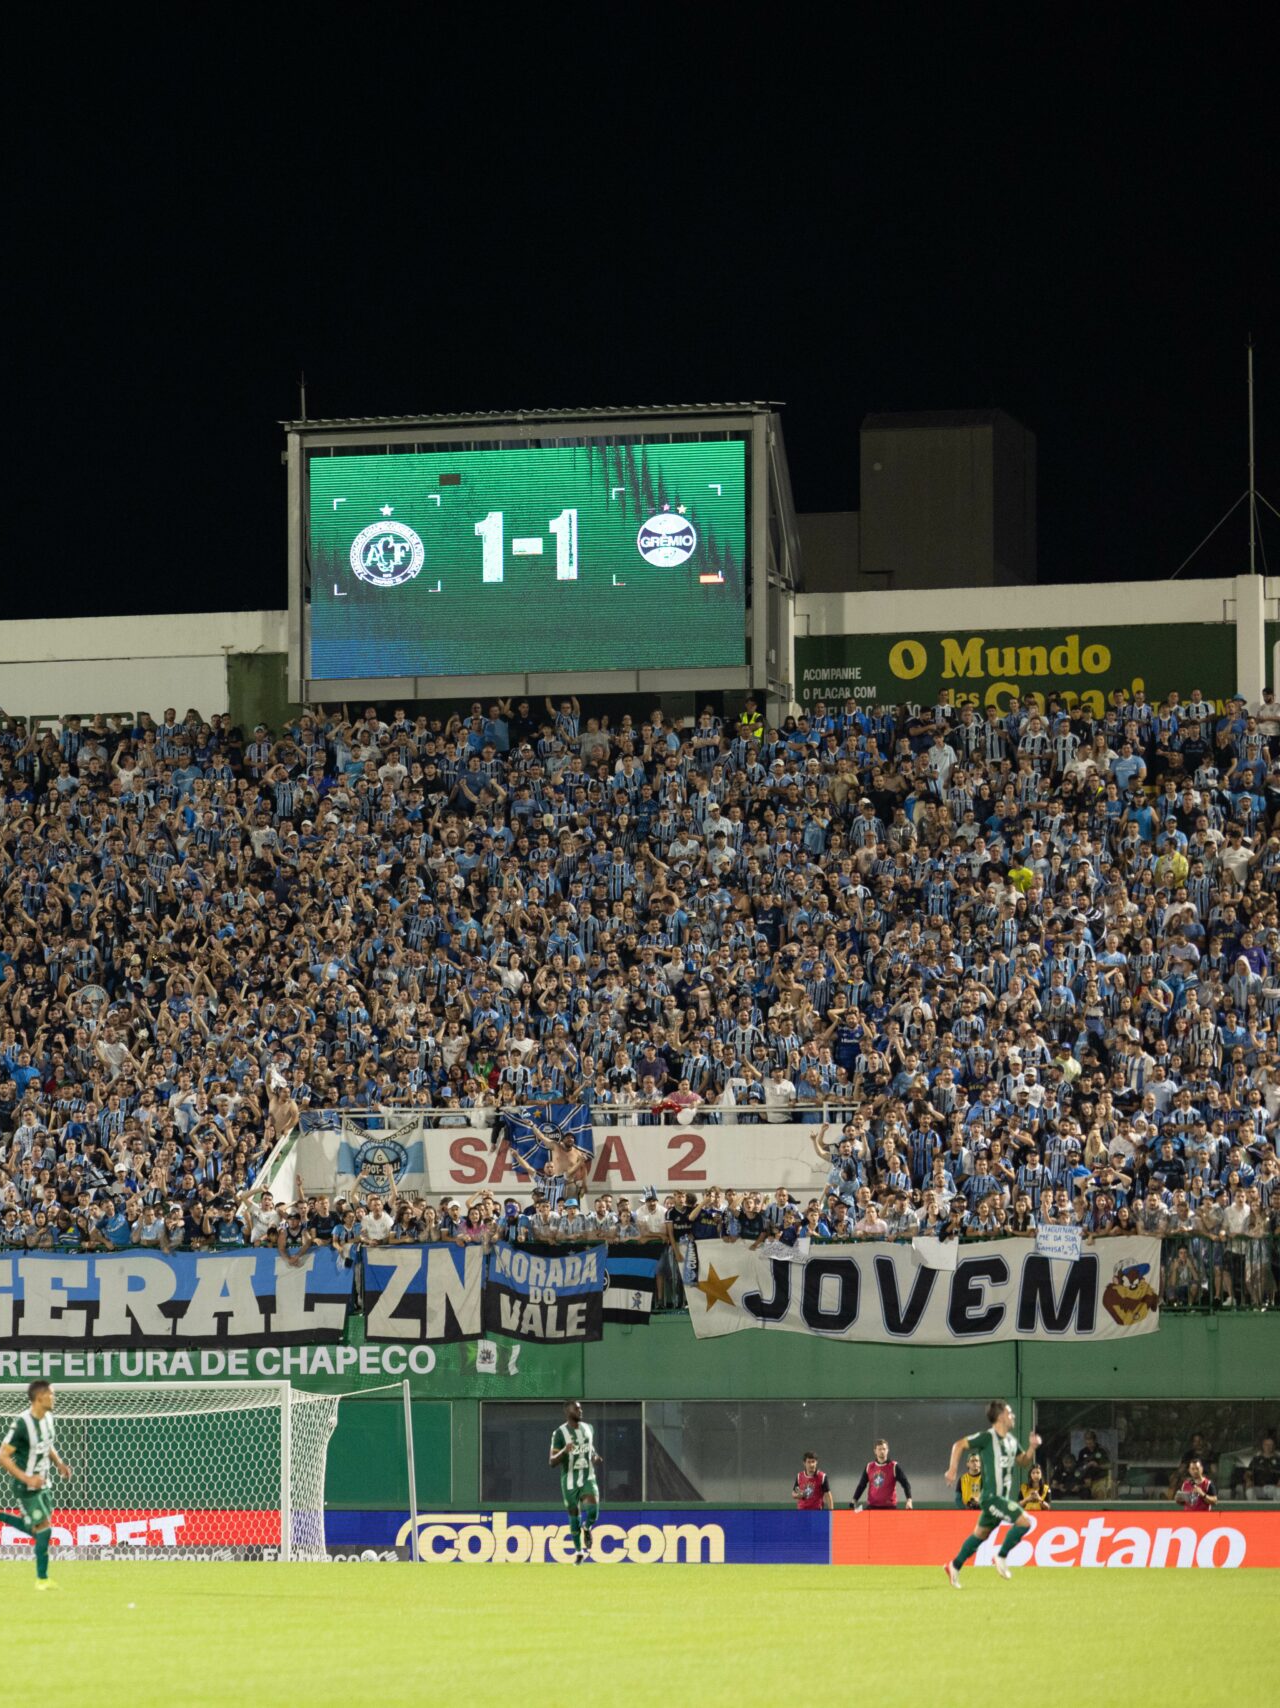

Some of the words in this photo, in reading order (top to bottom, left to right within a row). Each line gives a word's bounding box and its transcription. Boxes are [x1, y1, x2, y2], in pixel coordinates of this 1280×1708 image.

[640, 532, 693, 548] GRÊMIO
[803, 667, 862, 681] ACOMPANHE
[889, 640, 927, 680] O
[940, 634, 1111, 678] Mundo
[803, 688, 810, 700] O
[813, 687, 851, 700] PLACAR
[854, 686, 877, 698] COM
[667, 1134, 707, 1181] 2
[495, 1245, 599, 1288] MORADA
[366, 1244, 482, 1339] ZN
[529, 1286, 557, 1304] DO
[741, 1253, 1099, 1338] JOVEM
[500, 1293, 587, 1339] VALE
[201, 1348, 250, 1376] DE
